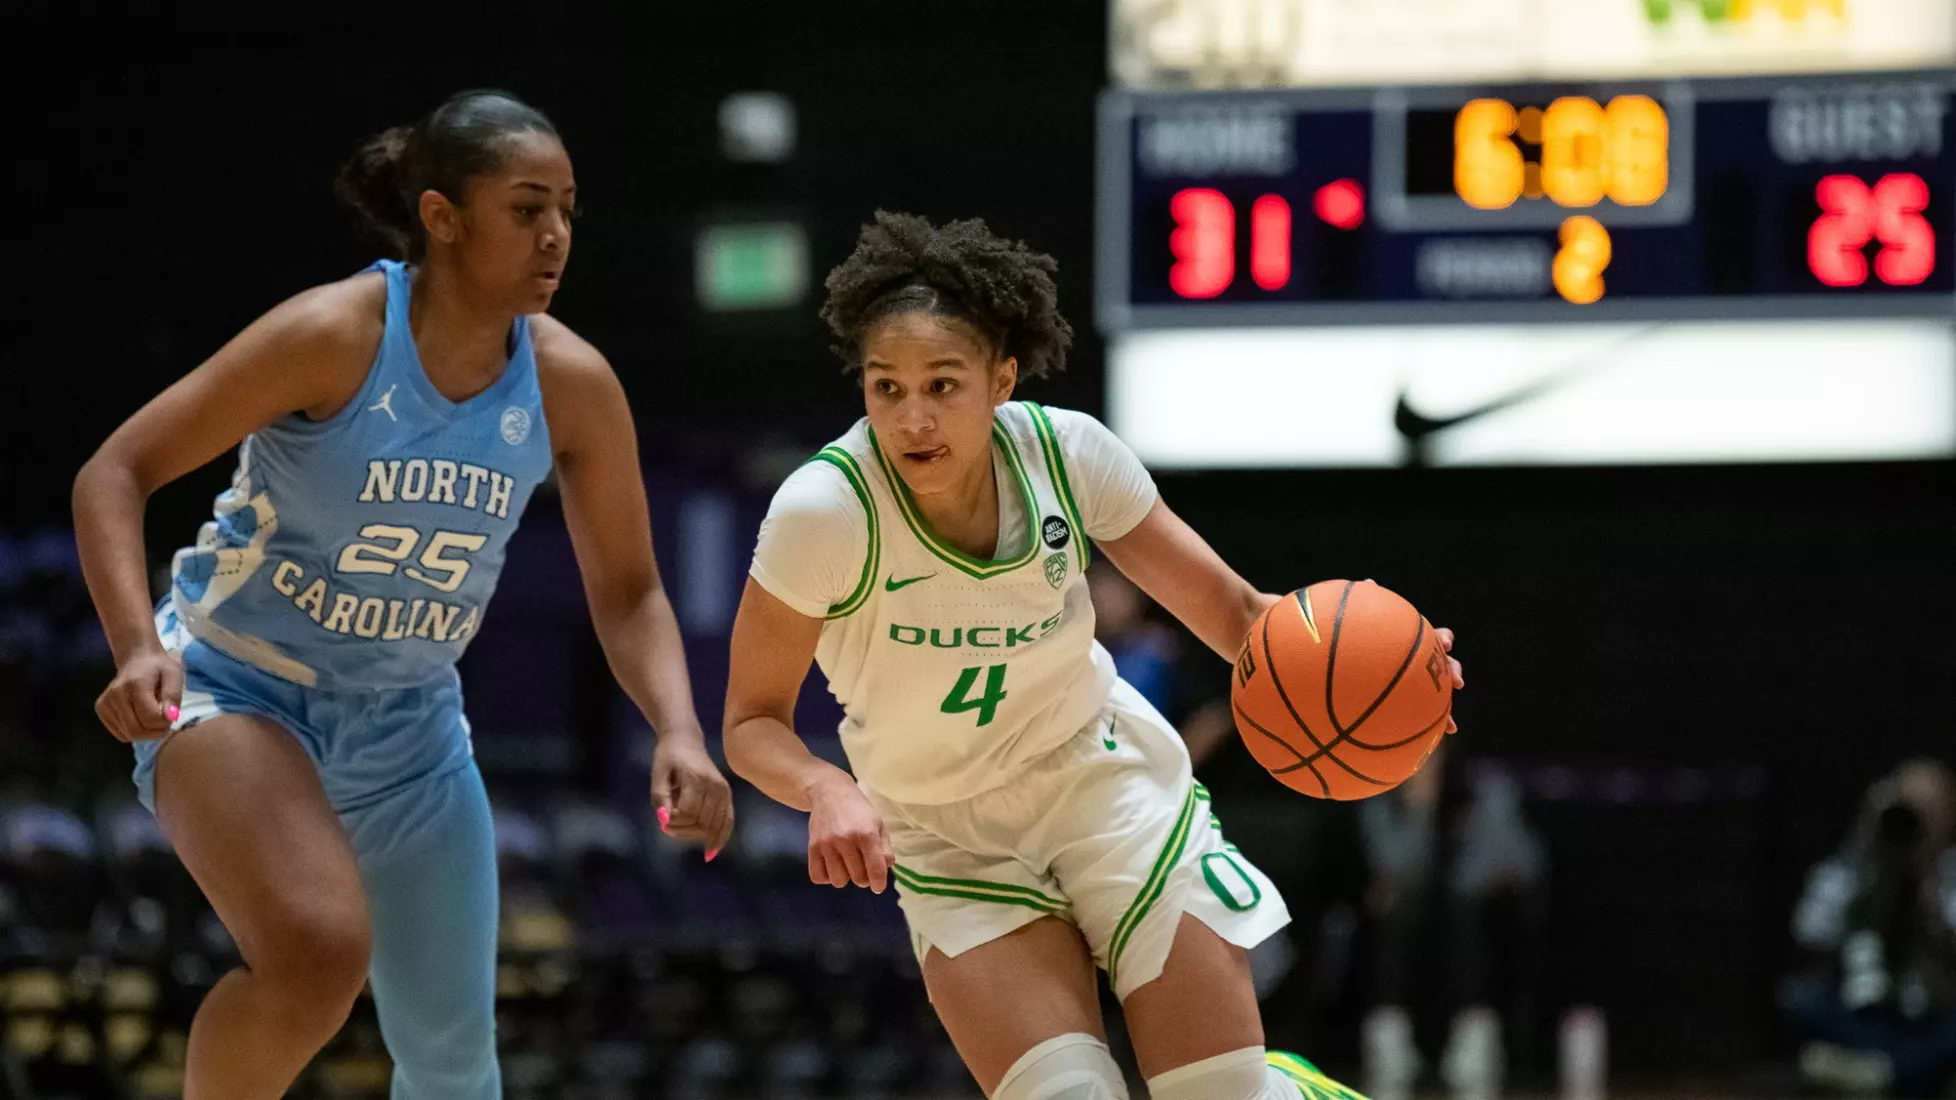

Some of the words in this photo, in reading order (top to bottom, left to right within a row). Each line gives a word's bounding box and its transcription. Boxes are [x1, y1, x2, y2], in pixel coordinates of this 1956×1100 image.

[1770, 84, 1945, 164] GUEST
[1169, 187, 1292, 299] 31
[1807, 172, 1936, 287] 25
[358, 458, 515, 519] NORTH
[336, 524, 489, 593] 25
[271, 559, 481, 642] CAROLINA
[889, 609, 1063, 648] DUCKS
[940, 663, 1008, 728] 4
